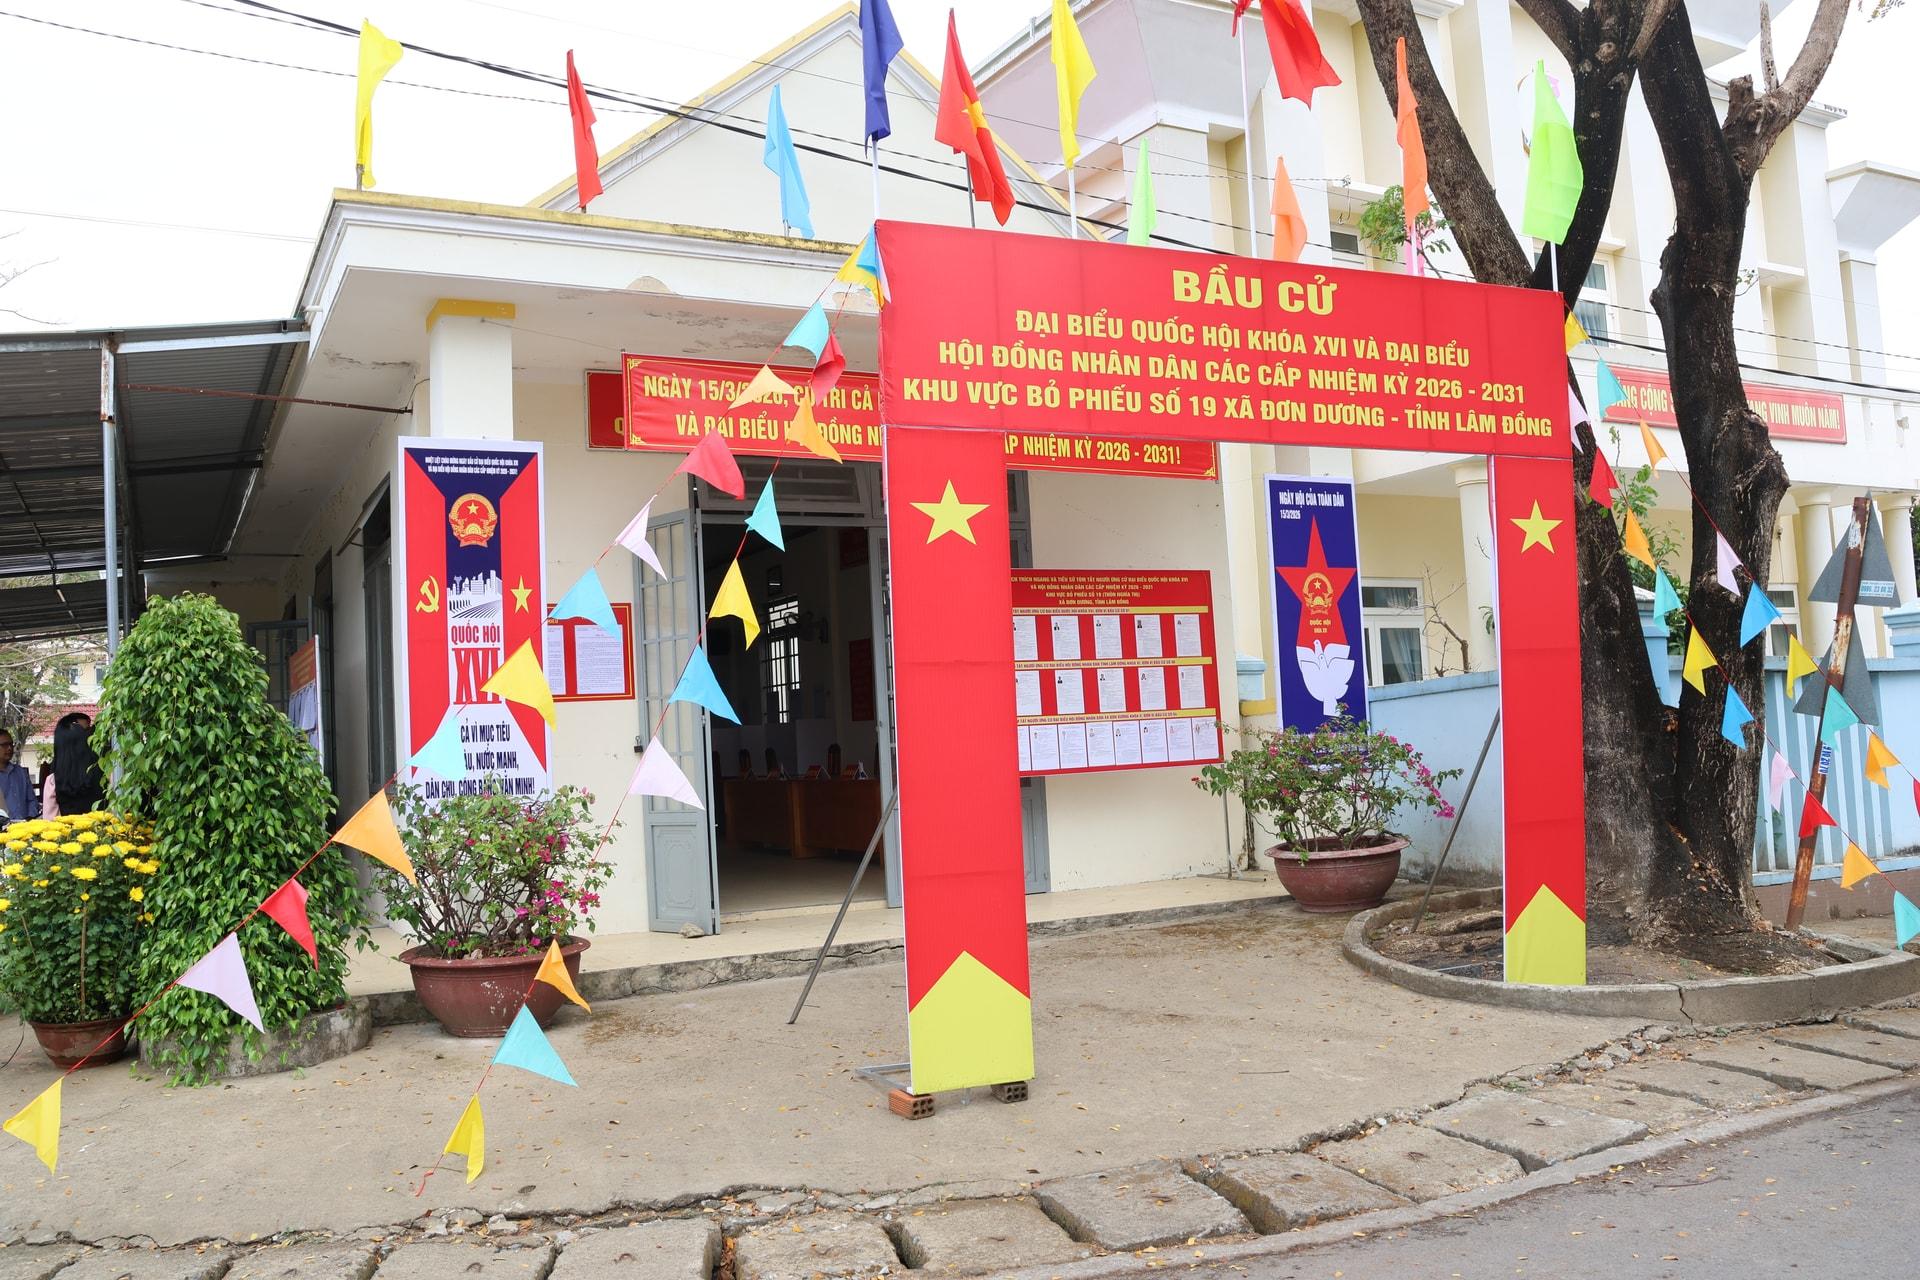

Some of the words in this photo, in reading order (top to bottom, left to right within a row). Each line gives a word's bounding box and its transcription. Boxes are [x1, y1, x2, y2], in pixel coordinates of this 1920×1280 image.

[1173, 264, 1262, 308] BẦU
[1278, 275, 1337, 315] CỬ
[1016, 310, 1058, 337] ĐẠI
[1068, 309, 1123, 338] BIỂU
[1132, 316, 1194, 344] QUỐC
[1203, 324, 1240, 352] HỘI
[1248, 329, 1306, 353] KHÓA
[1313, 336, 1346, 356] XVI
[1353, 337, 1380, 359] VÀ
[1386, 342, 1419, 366] ĐẠI
[1426, 340, 1469, 367] BIỂU
[940, 339, 983, 369] HỘI
[992, 340, 1063, 370] ĐỒNG
[1072, 350, 1140, 376] NHÂN
[1149, 354, 1197, 380] DÂN
[1206, 359, 1250, 383] CÁC
[1258, 360, 1301, 386] CẤP
[1309, 368, 1376, 395] NHIỆM
[1384, 372, 1408, 394] KỲ
[1416, 378, 1462, 398] 2026
[1482, 383, 1523, 403] 2031
[644, 373, 692, 400] NGÀY
[852, 384, 874, 411] CẢ
[904, 378, 957, 402] KHU
[967, 381, 1017, 409] VỰC
[1027, 379, 1060, 408] BỎ
[1069, 385, 1141, 412] PHIẾU
[1150, 387, 1180, 414] SỐ
[1190, 396, 1216, 416] 19
[1224, 398, 1254, 419] XÃ
[1261, 400, 1306, 422] ĐƠN
[1314, 403, 1384, 426] DƯƠNG
[1405, 404, 1449, 430] TỈNH
[1456, 410, 1496, 433] LÂM
[1502, 411, 1551, 436] ĐỒNG
[1640, 383, 1668, 416] CỘNG
[676, 411, 699, 436] VÀ
[740, 411, 779, 440] BIỂU
[1769, 402, 1790, 425] VINH
[1791, 402, 1816, 427] MUÔN
[1818, 404, 1840, 429] NĂM!
[1023, 433, 1071, 461] NHIỆM
[1074, 436, 1092, 459] KỲ
[1097, 441, 1130, 462] 2026
[1143, 444, 1181, 465] 2031!
[1280, 489, 1294, 504] NGÀY
[1295, 490, 1305, 508] HỘI
[1306, 488, 1317, 506] CỦA
[1318, 491, 1332, 506] TOÀN
[1333, 492, 1344, 506] DÂN
[452, 620, 479, 645] QUỐC
[483, 622, 500, 646] HỘI
[452, 648, 502, 704] XVI
[460, 718, 470, 742] CẢ
[471, 721, 478, 742] VÌ
[480, 725, 494, 747] MỤC
[496, 720, 510, 742] TIÊU
[476, 747, 494, 769] NƯỚC
[496, 751, 519, 772] MẠNH,
[426, 778, 440, 798] DÂN
[516, 777, 535, 794] MINH!
